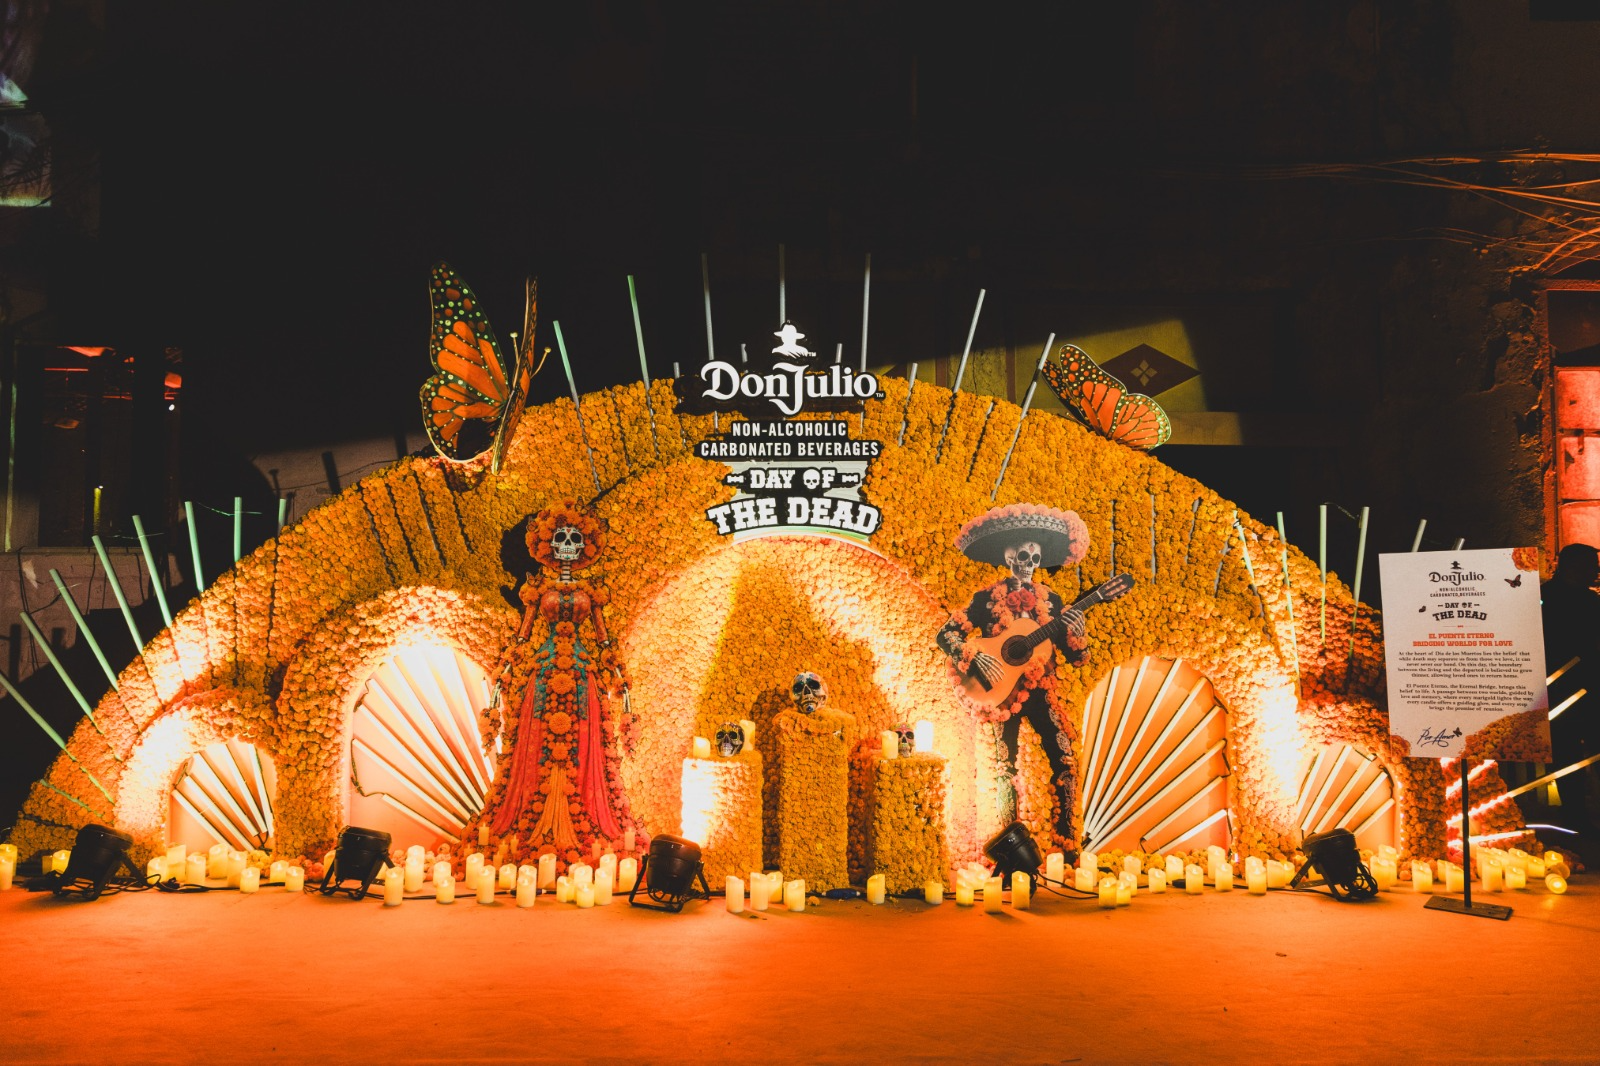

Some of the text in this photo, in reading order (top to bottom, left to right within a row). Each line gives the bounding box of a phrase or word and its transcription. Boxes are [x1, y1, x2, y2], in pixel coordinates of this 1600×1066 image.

[732, 423, 846, 436] NON-ALCOHOLIC
[701, 442, 879, 456] CARBONATED BEVERAGES
[750, 470, 795, 488] DAY
[708, 497, 880, 535] THE DEAD
[1432, 610, 1487, 621] THE DEAD
